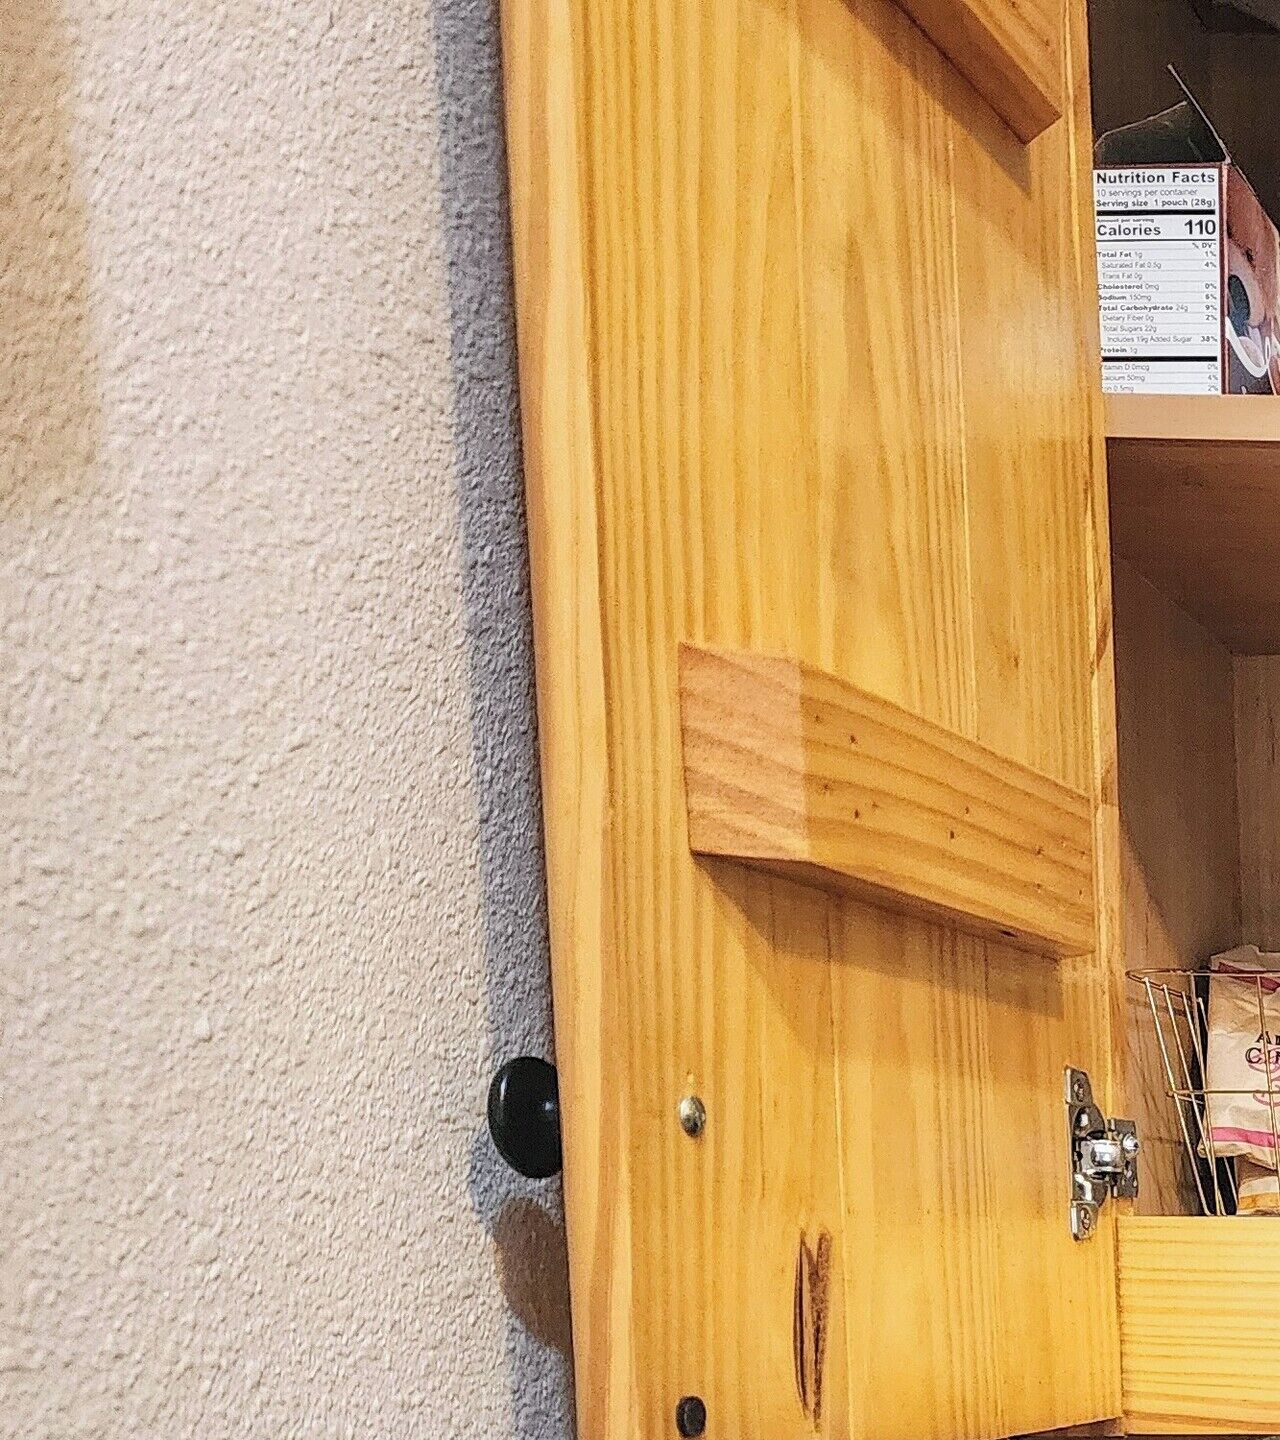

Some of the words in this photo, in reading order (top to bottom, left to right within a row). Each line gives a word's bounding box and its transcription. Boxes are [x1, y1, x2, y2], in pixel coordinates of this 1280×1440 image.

[1097, 172, 1165, 183] Nutrition
[1172, 172, 1215, 183] Facts
[1096, 200, 1128, 208] Serving
[1162, 199, 1188, 207] pouch
[1097, 225, 1161, 236] Calories
[1184, 219, 1216, 235] 110
